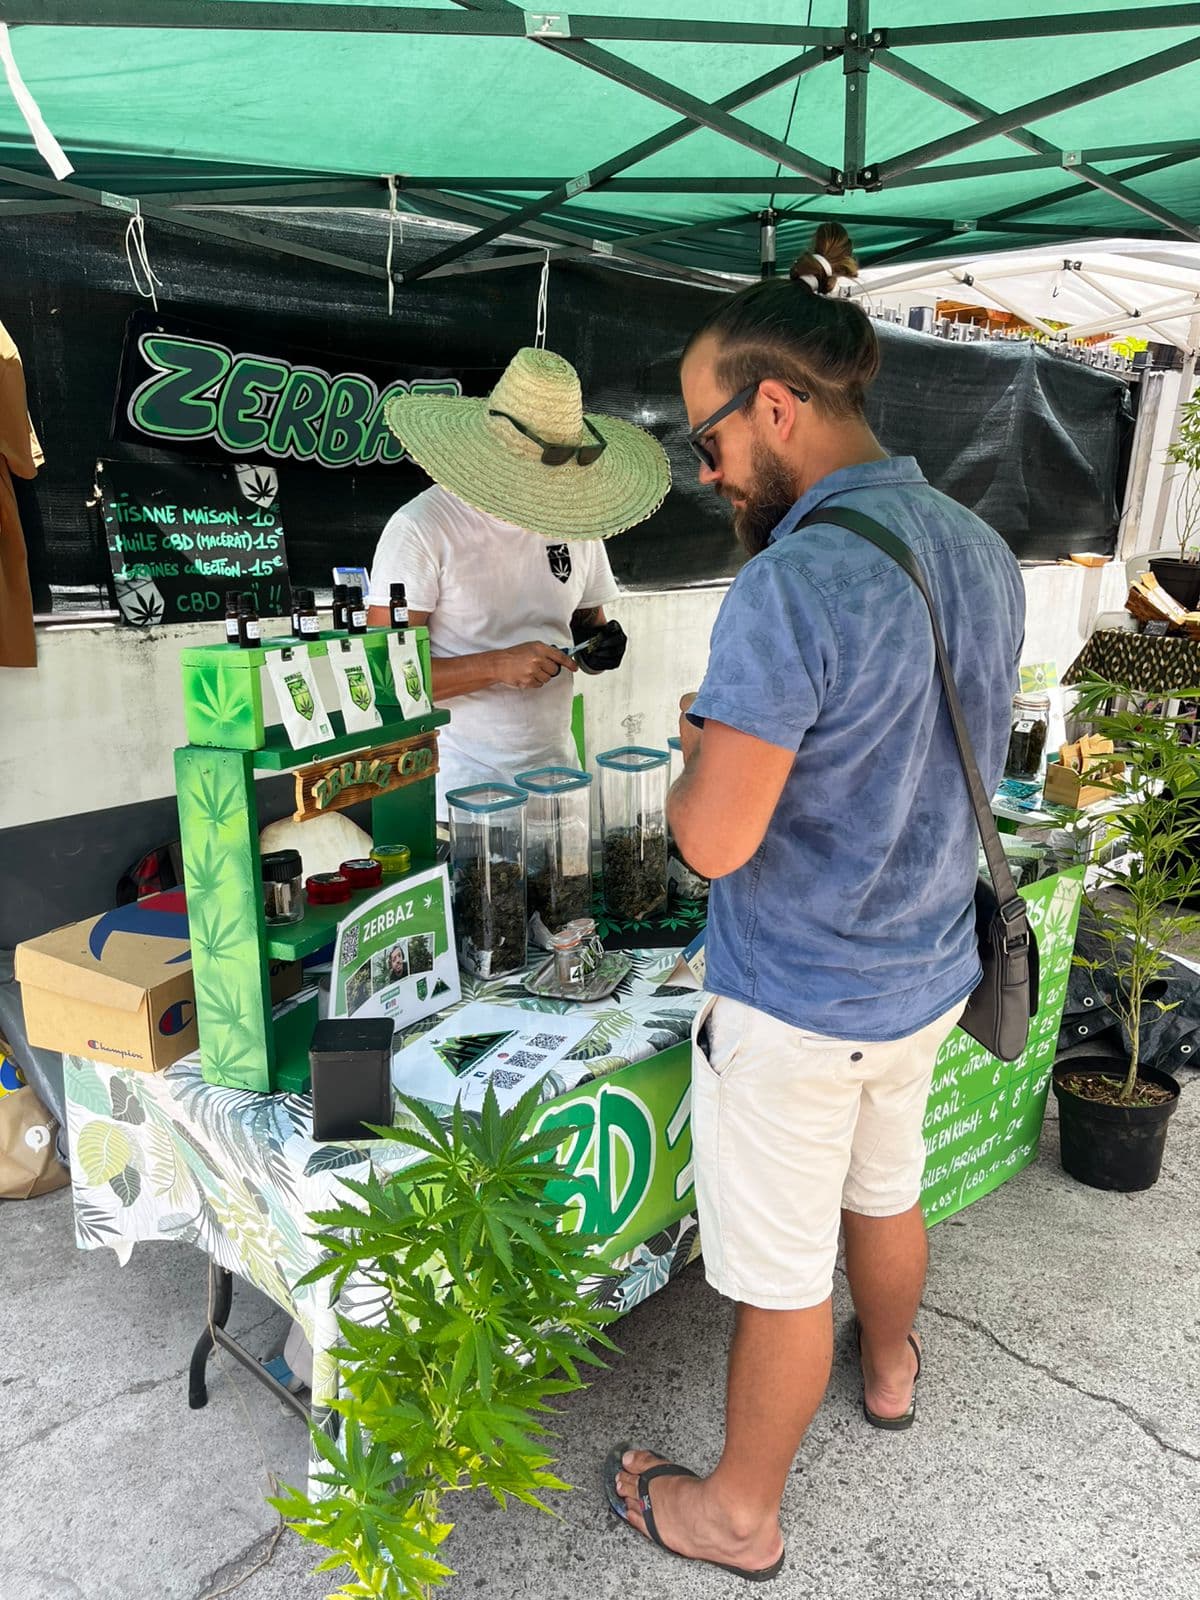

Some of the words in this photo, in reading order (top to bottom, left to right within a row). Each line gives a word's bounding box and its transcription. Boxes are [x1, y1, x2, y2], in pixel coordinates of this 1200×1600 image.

[129, 333, 461, 467] ZERBA
[162, 532, 194, 552] CBD
[176, 590, 221, 613] CBD
[311, 759, 392, 810] ZERBAZ
[397, 747, 433, 776] CBD
[362, 899, 415, 943] ZERBAZ
[87, 1039, 144, 1059] Champion
[928, 1066, 959, 1096] KUNK
[922, 1089, 965, 1129] ORAÏL:
